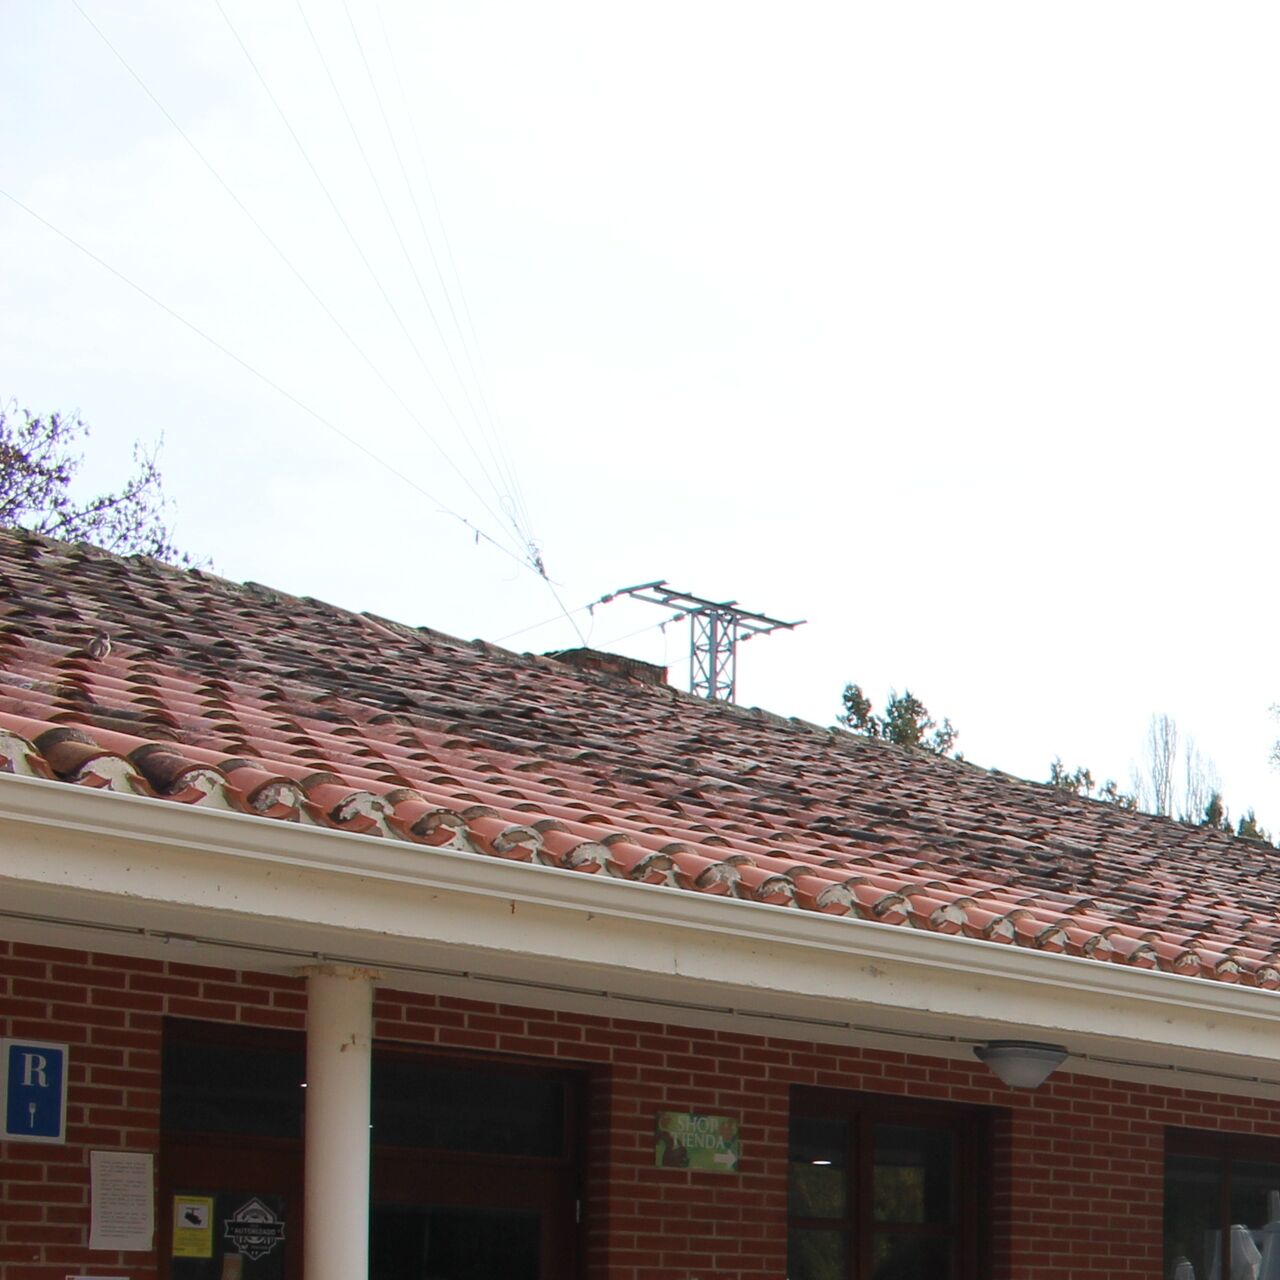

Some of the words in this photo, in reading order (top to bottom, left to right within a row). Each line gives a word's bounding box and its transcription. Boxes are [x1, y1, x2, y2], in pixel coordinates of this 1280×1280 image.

[20, 1053, 49, 1087] R
[678, 1116, 719, 1132] SHOP
[671, 1131, 725, 1149] TIENDA
[234, 1227, 276, 1236] AUTORIZADO
